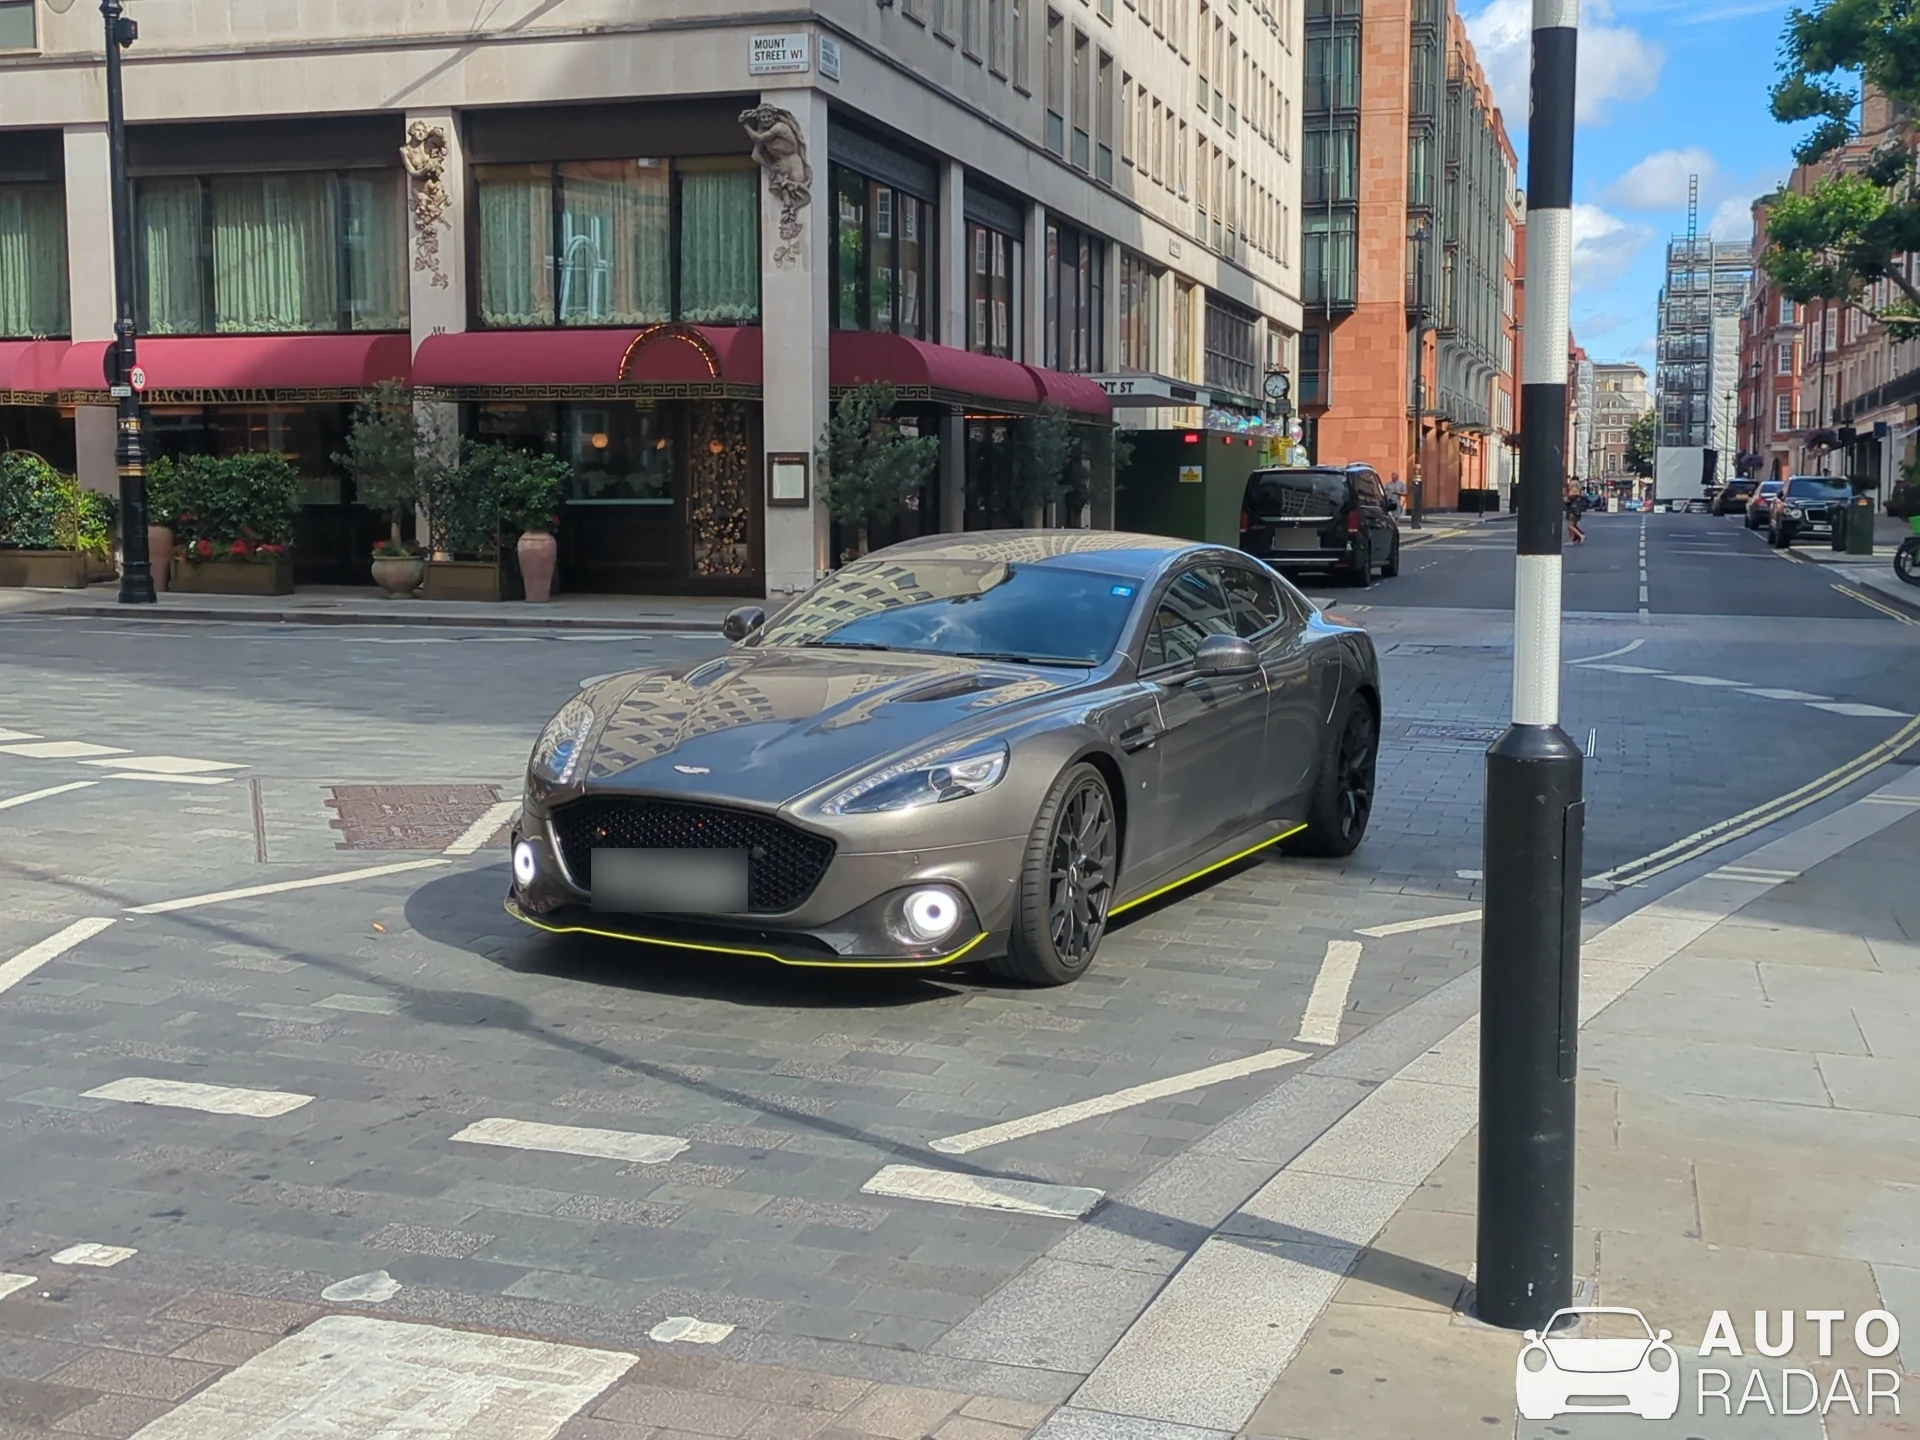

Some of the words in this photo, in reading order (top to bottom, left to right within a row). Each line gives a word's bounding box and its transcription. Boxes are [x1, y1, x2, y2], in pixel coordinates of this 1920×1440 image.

[754, 38, 786, 49] MOUNT
[754, 50, 786, 61] STREET
[790, 49, 803, 60] W1
[133, 372, 144, 384] 20
[1096, 381, 1117, 394] NT
[1120, 381, 1135, 394] ST
[148, 388, 269, 403] BACCHANALIA
